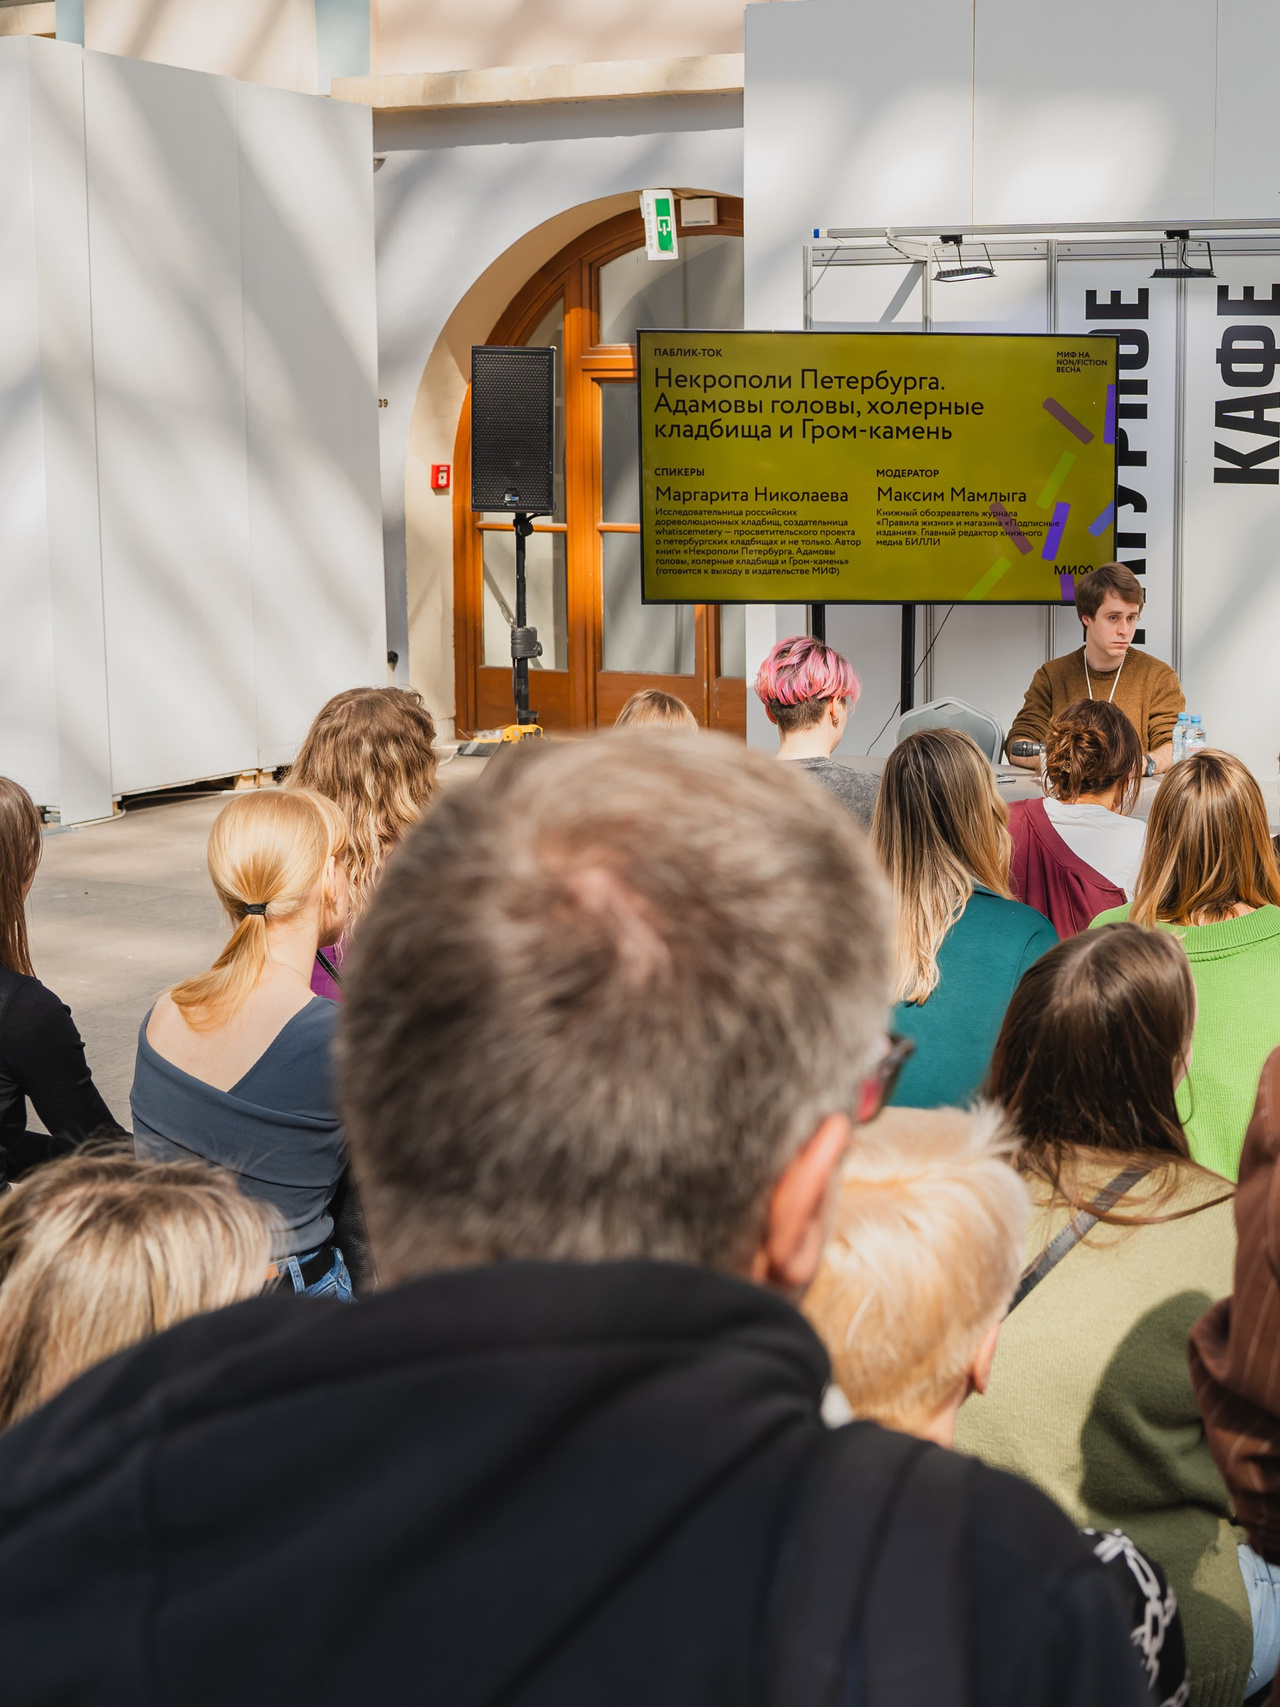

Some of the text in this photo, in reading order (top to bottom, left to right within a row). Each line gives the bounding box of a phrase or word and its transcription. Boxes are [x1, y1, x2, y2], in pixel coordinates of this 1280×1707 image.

[654, 348, 722, 357] ПАБЛИК-ТОК
[654, 367, 945, 393] Некрополи Петербурга.
[653, 392, 984, 421] Адамовы головы, холерные
[655, 418, 952, 444] кладбища и Гром-камень
[654, 468, 704, 476] СПИКЕРЫ
[877, 469, 939, 478] МОДЕРАТОР
[656, 486, 848, 505] Маргарита Николаева
[878, 487, 1026, 502] Максим Мамлыга
[655, 508, 797, 517] Исследовательница российских
[876, 509, 917, 517] Книжный
[741, 518, 781, 527] кладбищ,
[784, 519, 848, 527] создательница
[876, 519, 919, 527] «Правила
[1005, 519, 1060, 527] «Подписные
[655, 528, 722, 537] whatiscemetery
[734, 529, 817, 537] просветительского
[820, 529, 855, 537] проекта
[730, 538, 778, 546] кладбищах
[905, 538, 940, 546] БИЛЛИ
[683, 548, 738, 556] «Некрополи
[741, 548, 794, 556] Петербурга.
[796, 548, 835, 556] Адамовы
[656, 567, 702, 576] (готовится
[711, 568, 742, 576] выходу
[752, 568, 810, 576] издательстве
[812, 567, 839, 576] МИФ)
